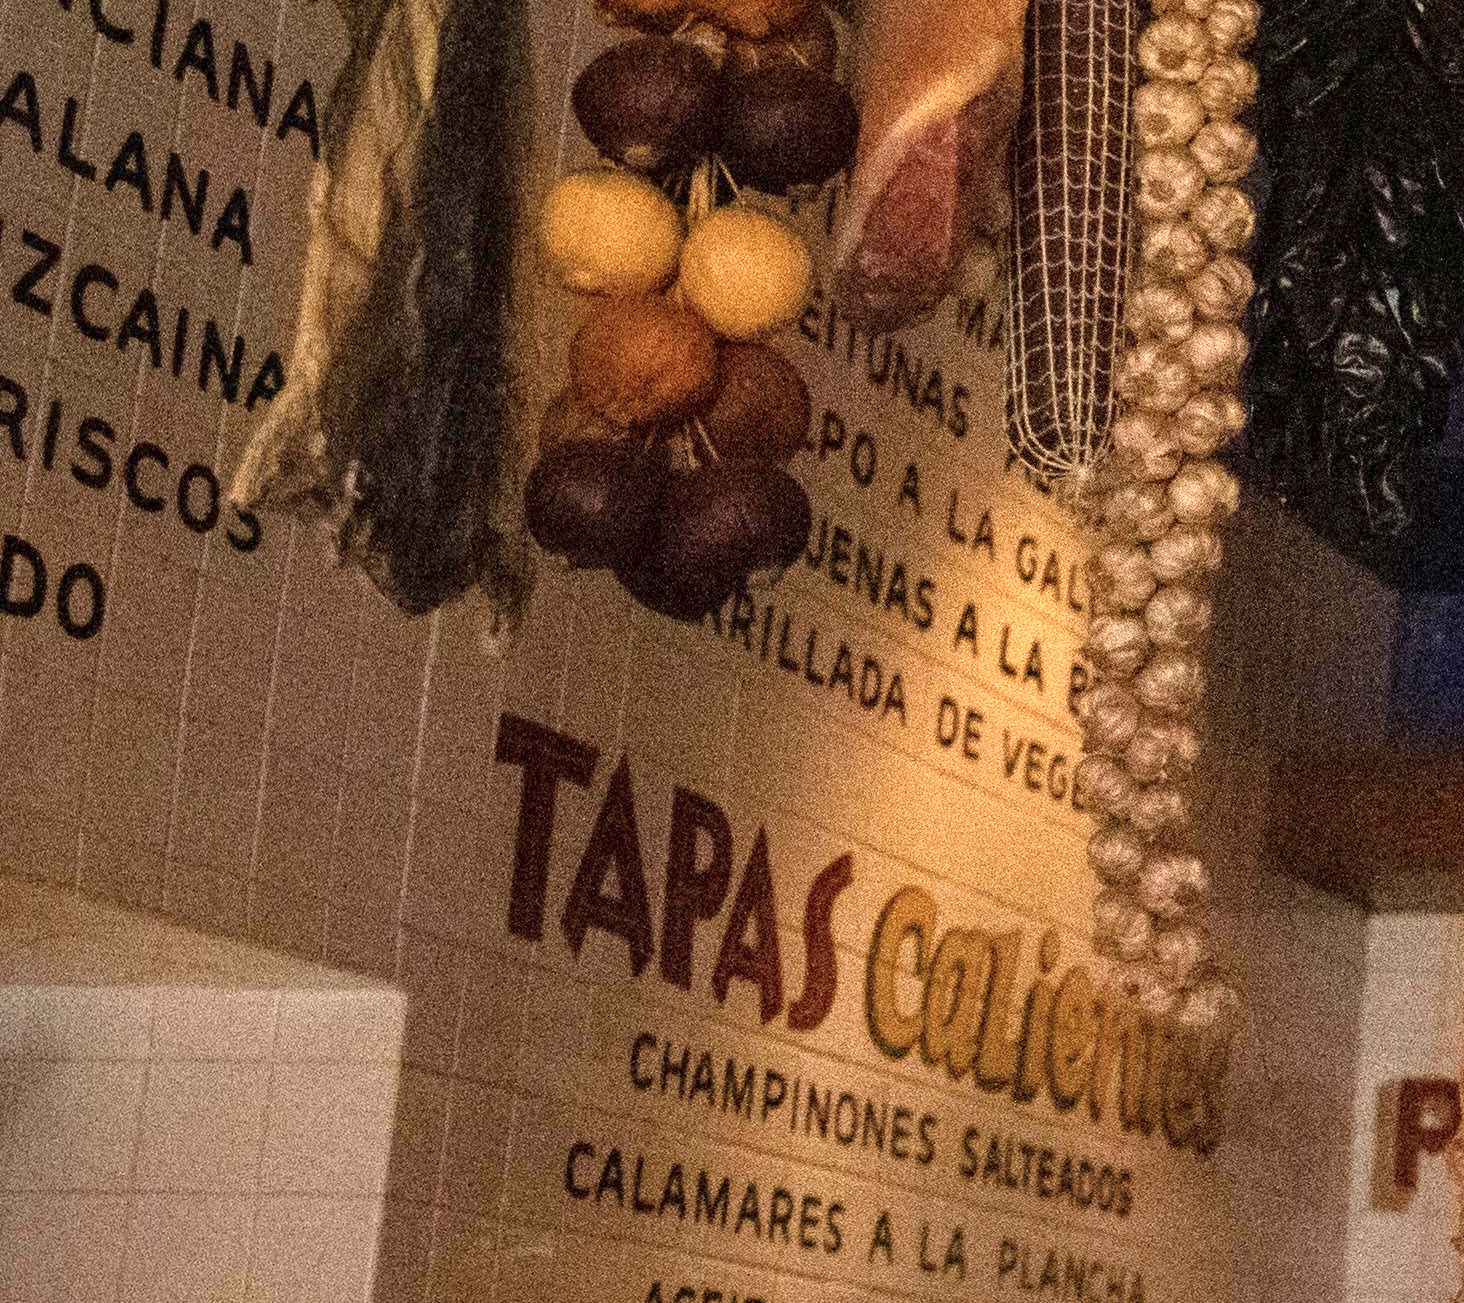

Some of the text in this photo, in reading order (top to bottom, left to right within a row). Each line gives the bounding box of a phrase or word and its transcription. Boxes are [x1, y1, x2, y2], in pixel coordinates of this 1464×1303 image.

[804, 409, 877, 488] PO
[900, 461, 922, 517] A
[946, 490, 995, 564] LA
[953, 601, 979, 660] A
[999, 623, 1044, 696] LA
[936, 693, 984, 763] DE
[495, 712, 853, 1032] TAPAS
[629, 1028, 1133, 1219] CHAMPINONES SALTEADOS
[565, 1141, 845, 1254] CALAMARES
[867, 1210, 895, 1268] A
[918, 1221, 968, 1282] LA
